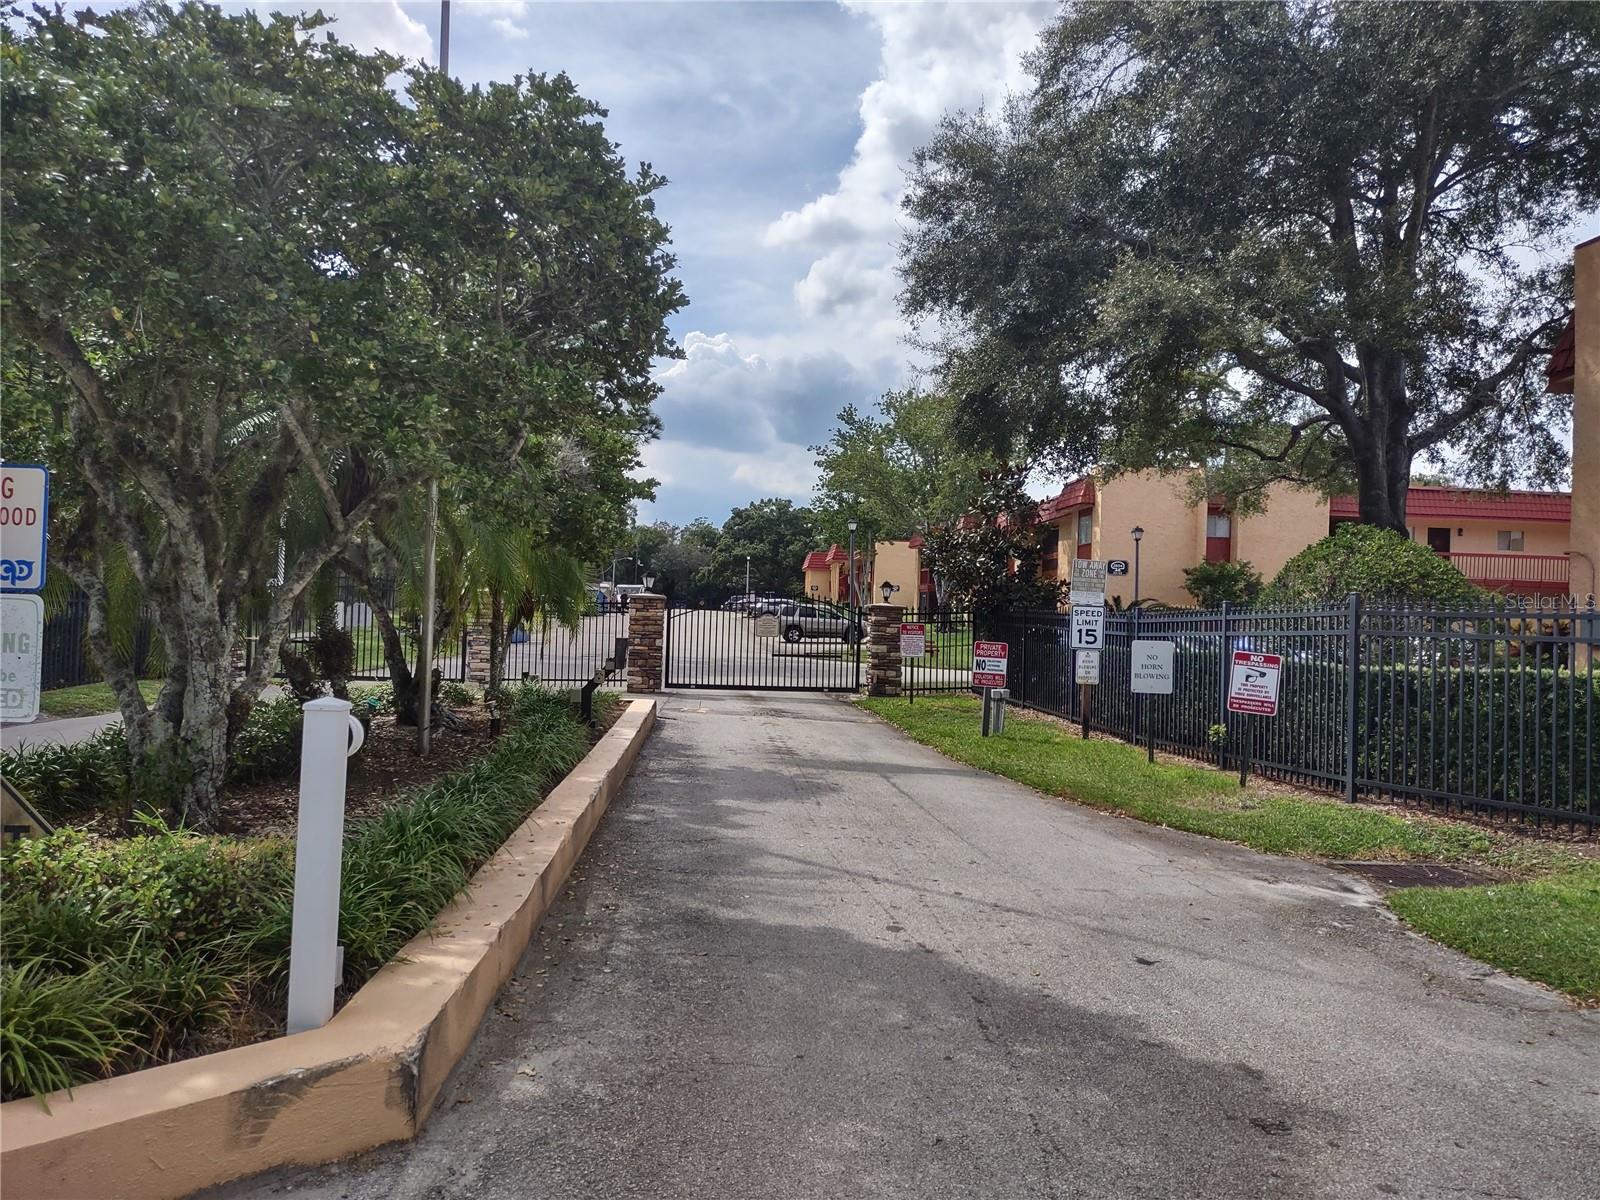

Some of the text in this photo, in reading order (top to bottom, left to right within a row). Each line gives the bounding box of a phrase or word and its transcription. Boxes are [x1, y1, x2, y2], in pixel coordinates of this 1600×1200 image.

[1074, 560, 1106, 570] TOW AWAY
[1081, 569, 1098, 578] ZONE
[1074, 609, 1103, 617] SPEED
[1077, 628, 1097, 645] 15
[979, 643, 1002, 651] PRIVATE
[976, 649, 1005, 657] PROPERTY
[975, 659, 987, 671] NO
[1235, 660, 1279, 668] TRESPASSING
